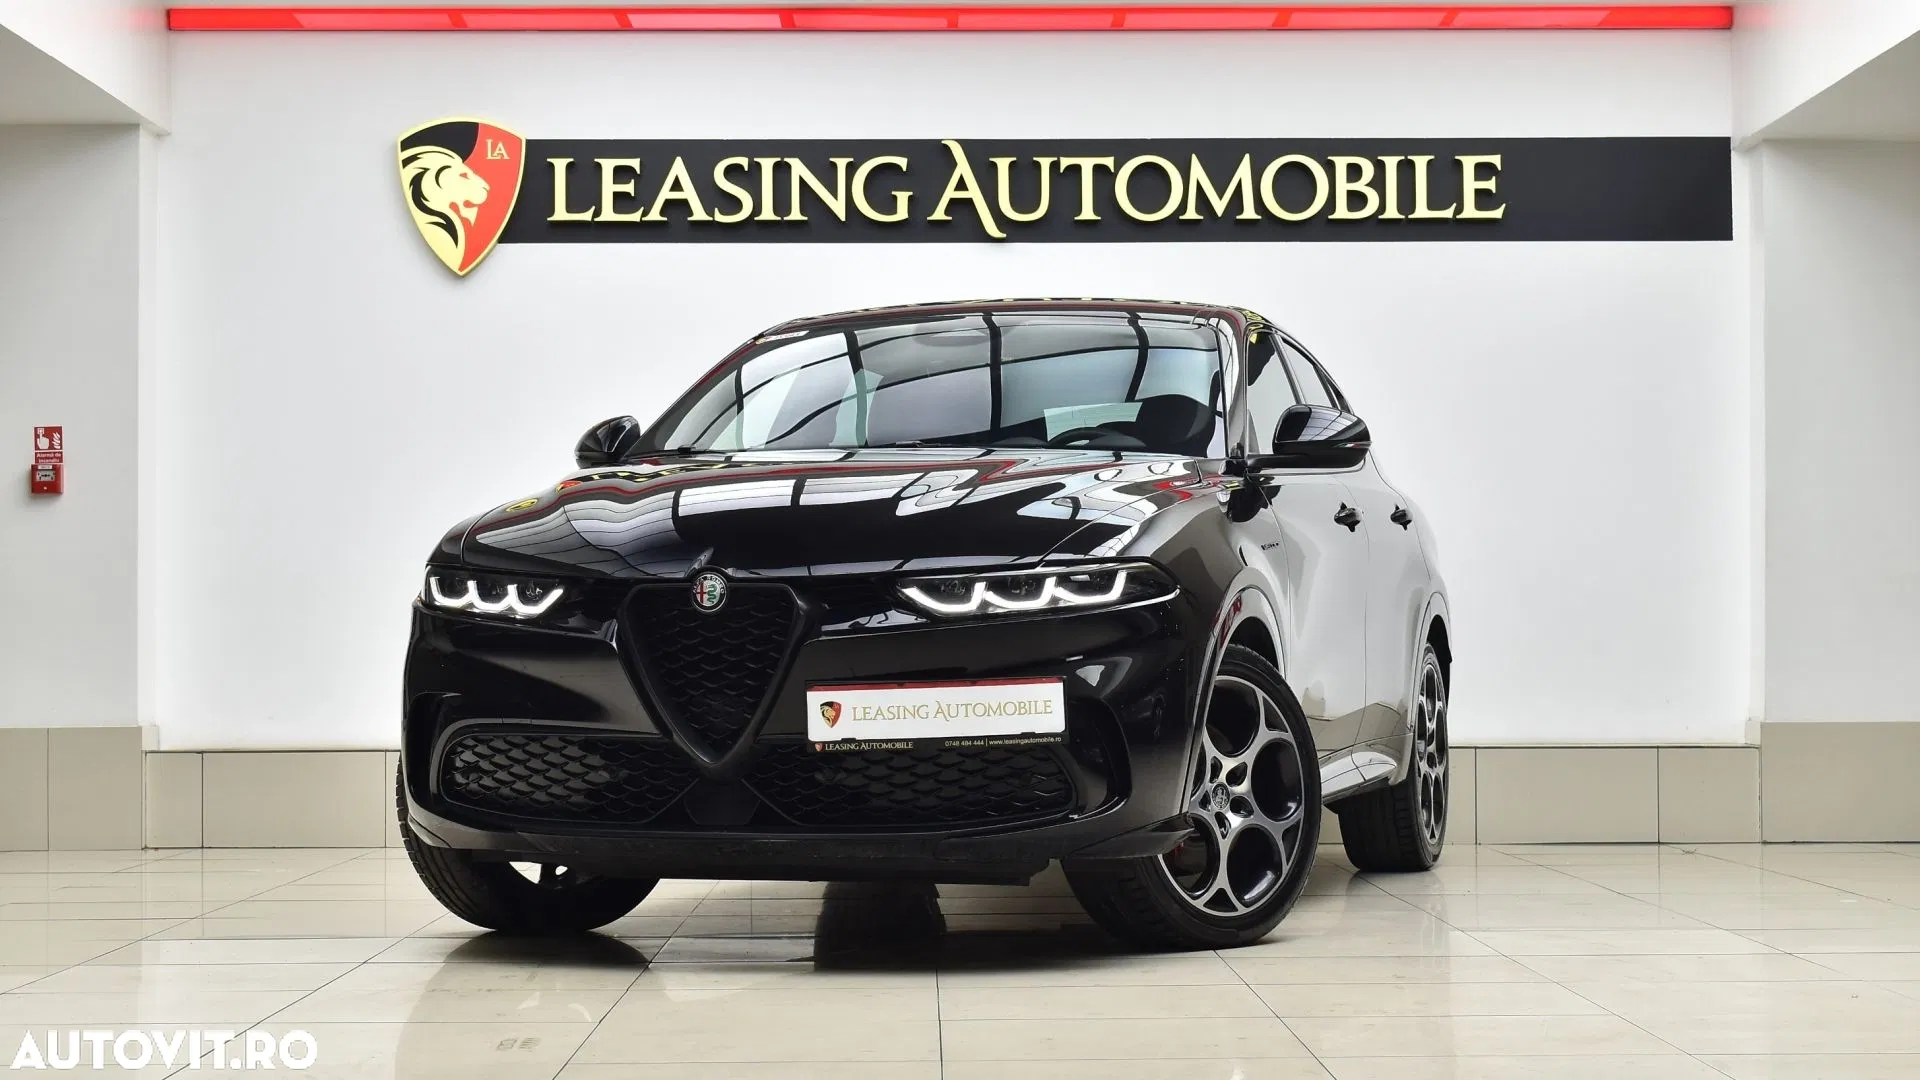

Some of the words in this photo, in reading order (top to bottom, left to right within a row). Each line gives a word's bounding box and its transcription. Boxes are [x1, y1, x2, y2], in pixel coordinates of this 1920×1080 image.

[486, 138, 510, 160] LA
[546, 156, 914, 224] LEASING
[926, 139, 1506, 239] AUTOMOBILE
[852, 704, 930, 722] LEASING
[933, 700, 1053, 722] AUTOMOBILE
[825, 743, 859, 751] LEASING
[860, 742, 914, 751] AUTOMOBILE
[989, 737, 1062, 746] www.leasingautomobile.ro
